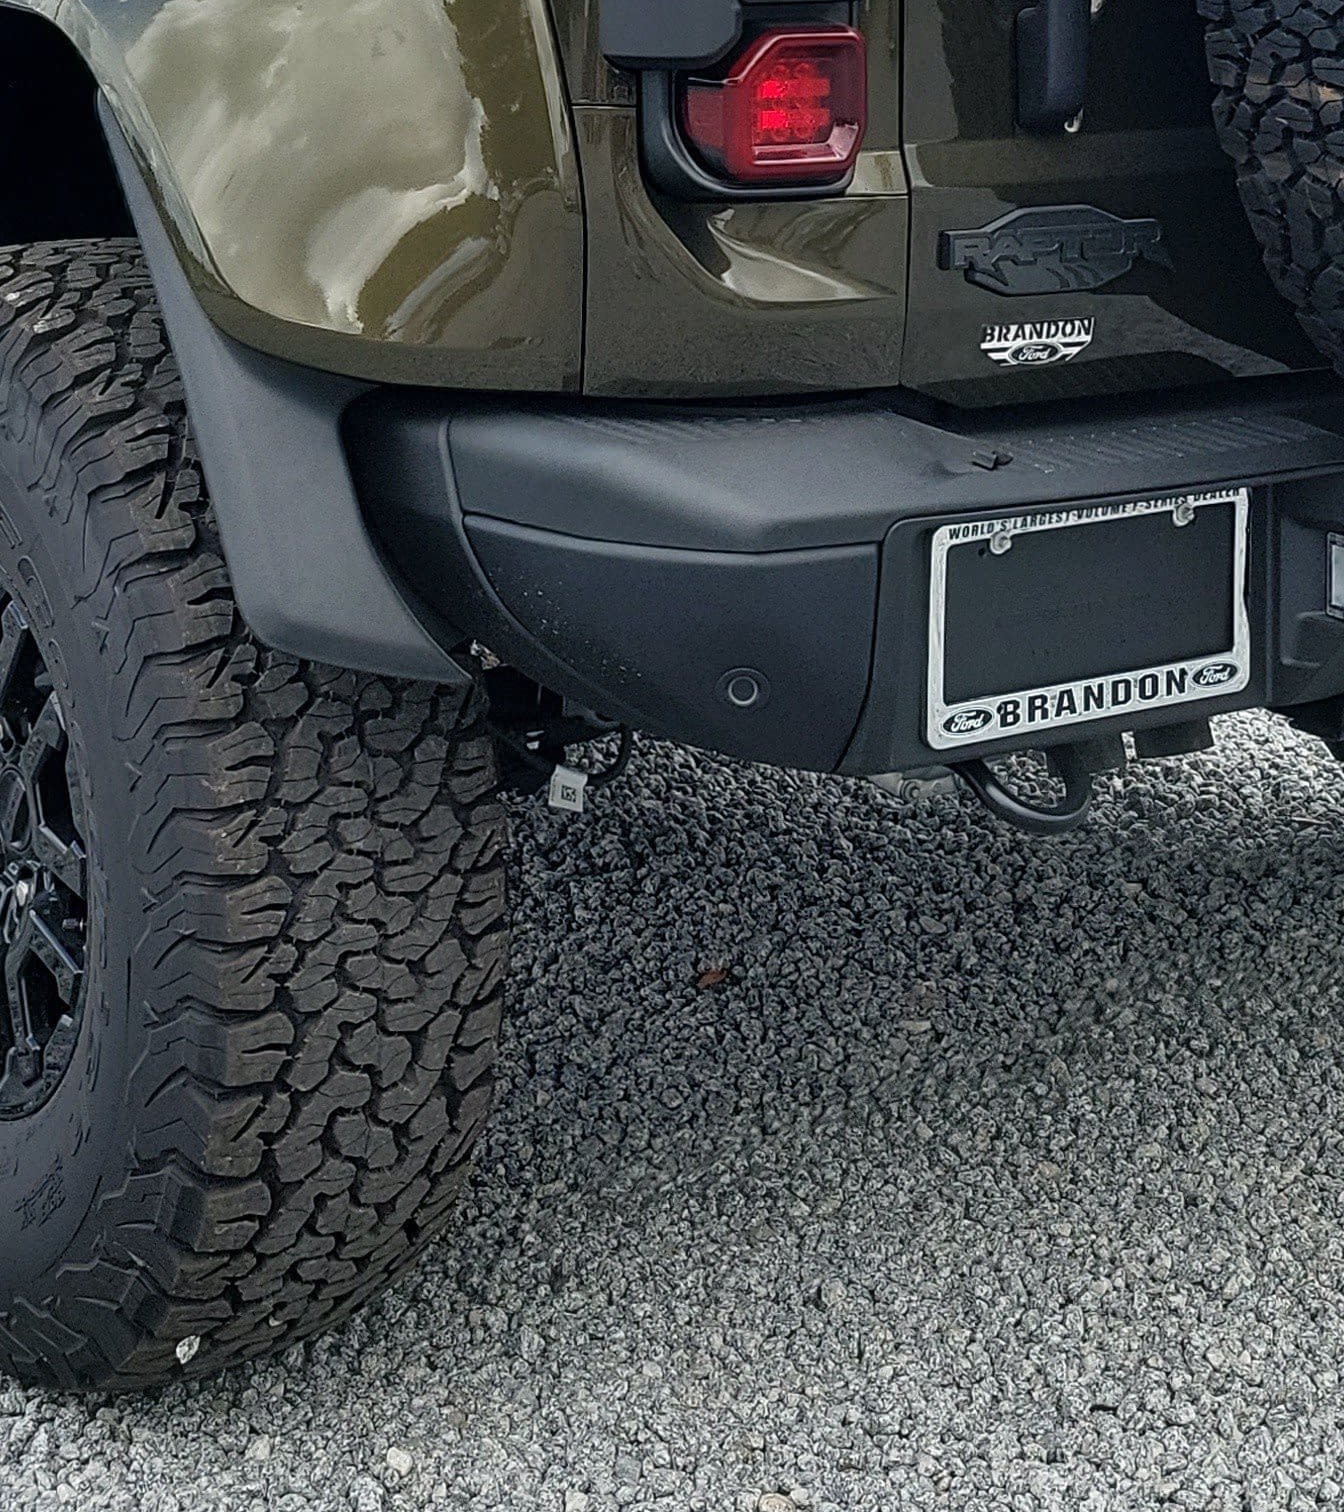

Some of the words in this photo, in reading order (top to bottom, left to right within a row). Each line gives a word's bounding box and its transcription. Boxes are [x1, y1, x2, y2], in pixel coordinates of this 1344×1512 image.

[950, 220, 1172, 286] RAPTOR
[984, 317, 1092, 343] BRANDON
[947, 519, 1008, 541] WORLD'S
[1011, 511, 1071, 531] LARGEST
[999, 667, 1188, 728] BRANDON
